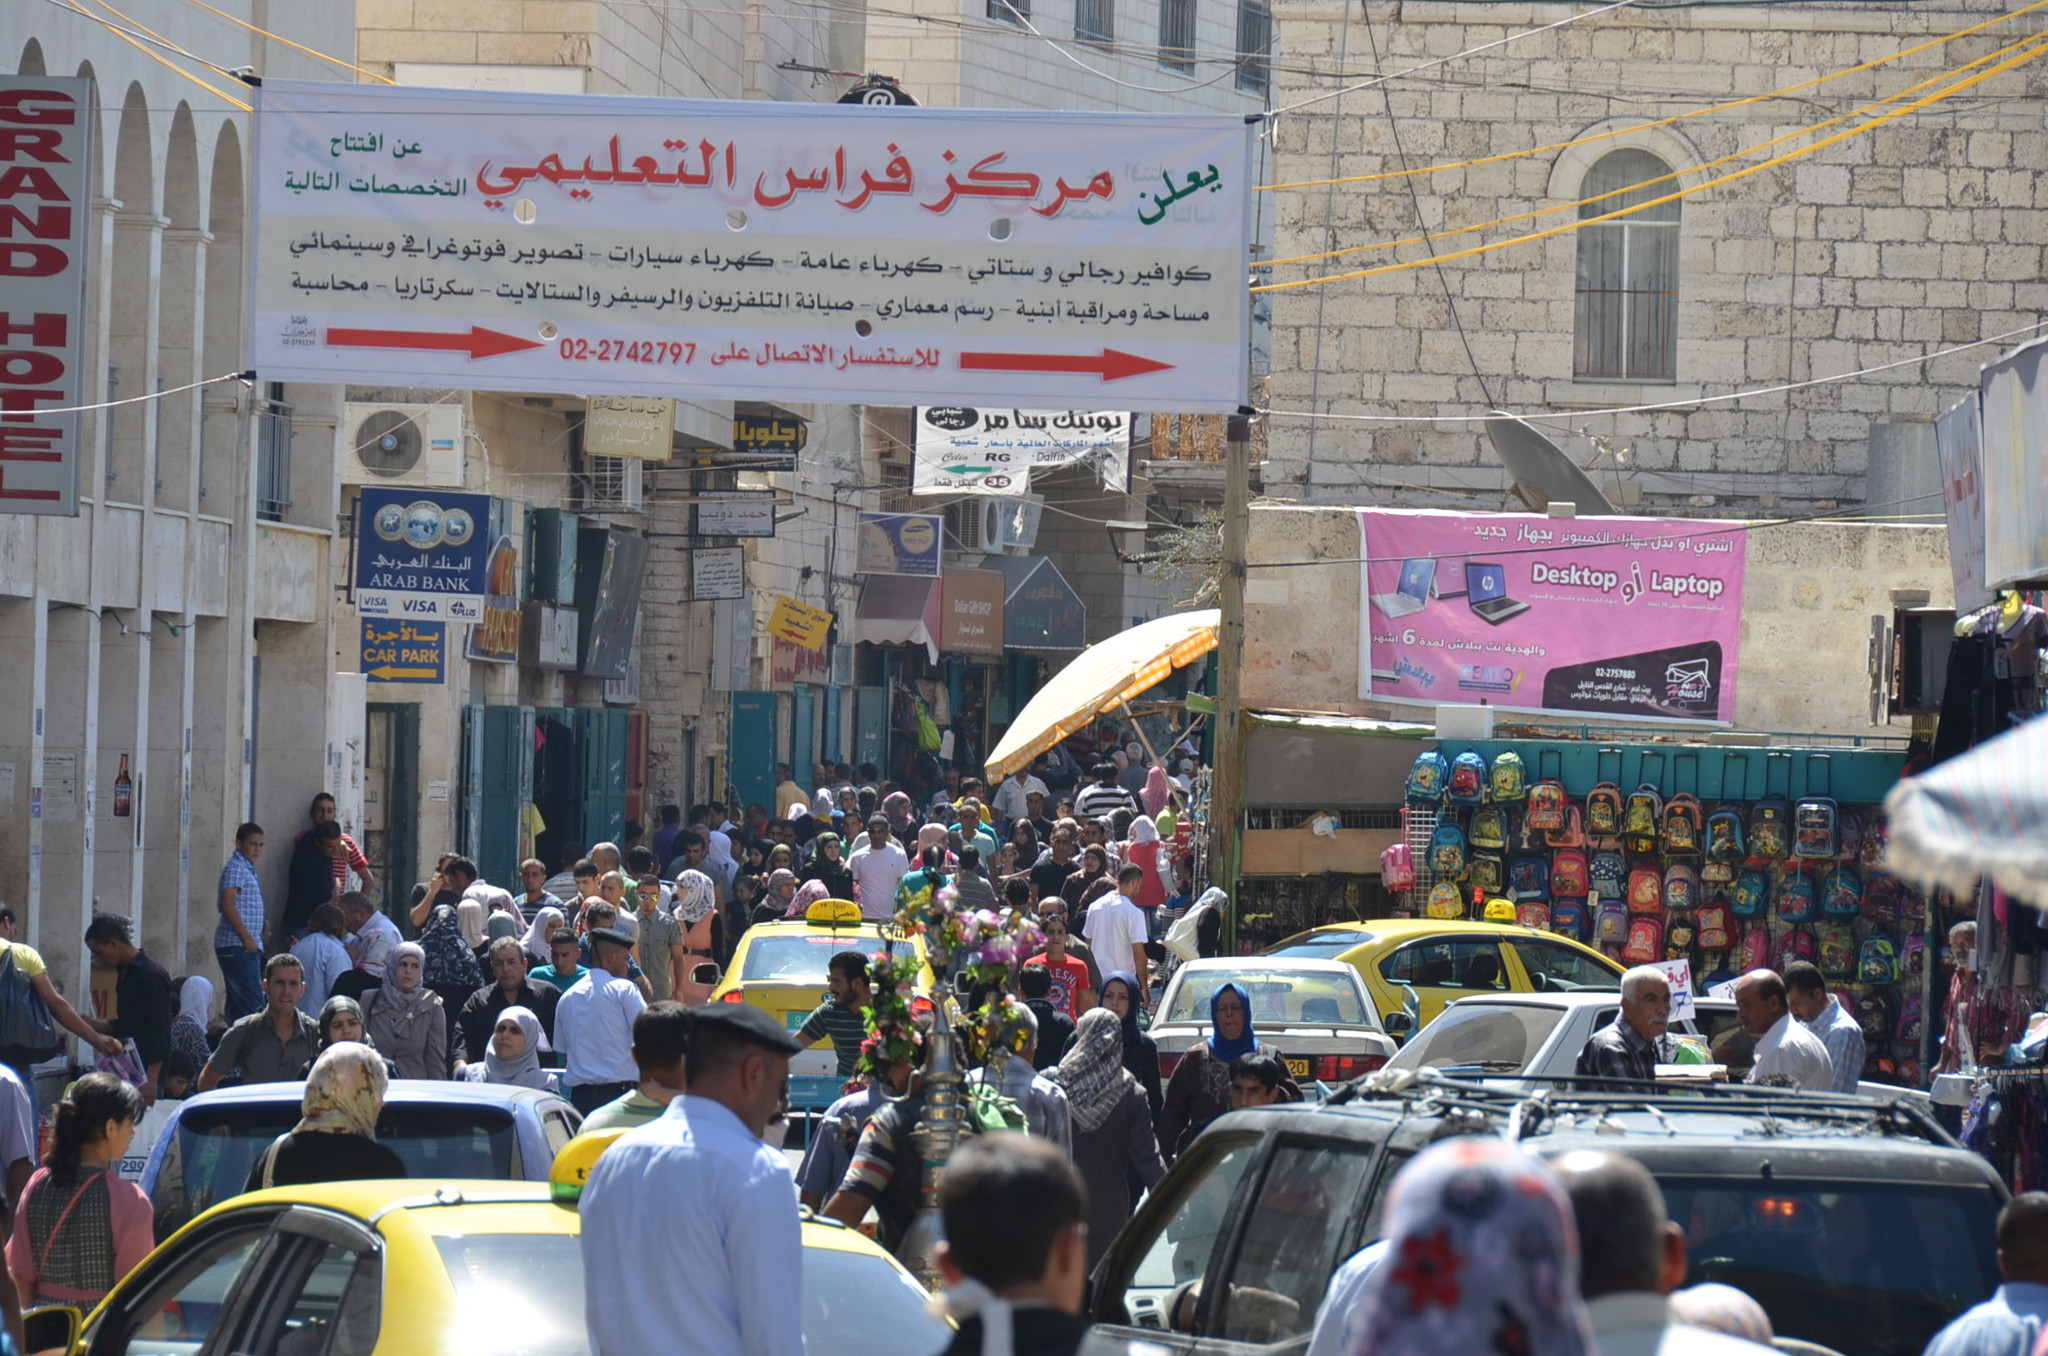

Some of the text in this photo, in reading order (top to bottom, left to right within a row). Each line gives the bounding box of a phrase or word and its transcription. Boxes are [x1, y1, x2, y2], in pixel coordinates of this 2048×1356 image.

[330, 132, 422, 159] عن افتتاح
[285, 171, 466, 197] التخصصات التالية
[476, 134, 1113, 219] مركز فراس التعليمي
[1138, 164, 1223, 225] يعلن
[510, 243, 583, 265] تصوير
[608, 246, 683, 269] سيارات
[690, 248, 774, 272] كهرباء
[801, 251, 851, 270] عامة
[859, 254, 943, 278] كهرباء
[1058, 261, 1125, 287] رجالي
[1131, 262, 1212, 286] كوافير
[292, 272, 369, 295] محاسبة
[395, 276, 474, 301] سكرتاريا
[496, 281, 601, 308] والستالايت
[603, 286, 693, 311] والرسيفر
[698, 290, 789, 313] التلفزيون
[796, 292, 854, 316] صيانة
[876, 296, 948, 321] معماري
[954, 304, 994, 323] رسم
[1066, 301, 1137, 326] ومراقبة
[1143, 303, 1209, 321] مساحة
[560, 338, 696, 364] 02-2742797
[710, 342, 750, 366] على
[835, 346, 940, 371] للاستفسار
[984, 453, 1011, 462] RG
[987, 477, 1010, 487] 35
[1473, 524, 1507, 541] جديد
[1516, 523, 1553, 544] بجهاز
[1694, 537, 1733, 557] اشتري
[371, 554, 471, 572] البنك العربي
[370, 574, 470, 592] ARAB BANK
[1532, 563, 1617, 593] Desktop
[1650, 572, 1723, 600] Laptop
[363, 597, 387, 607] VISA
[402, 599, 437, 613] VISA
[457, 608, 477, 617] PLUS
[1401, 629, 1415, 645] 6
[1419, 638, 1444, 647] لمدة
[364, 649, 440, 663] CAR PARK
